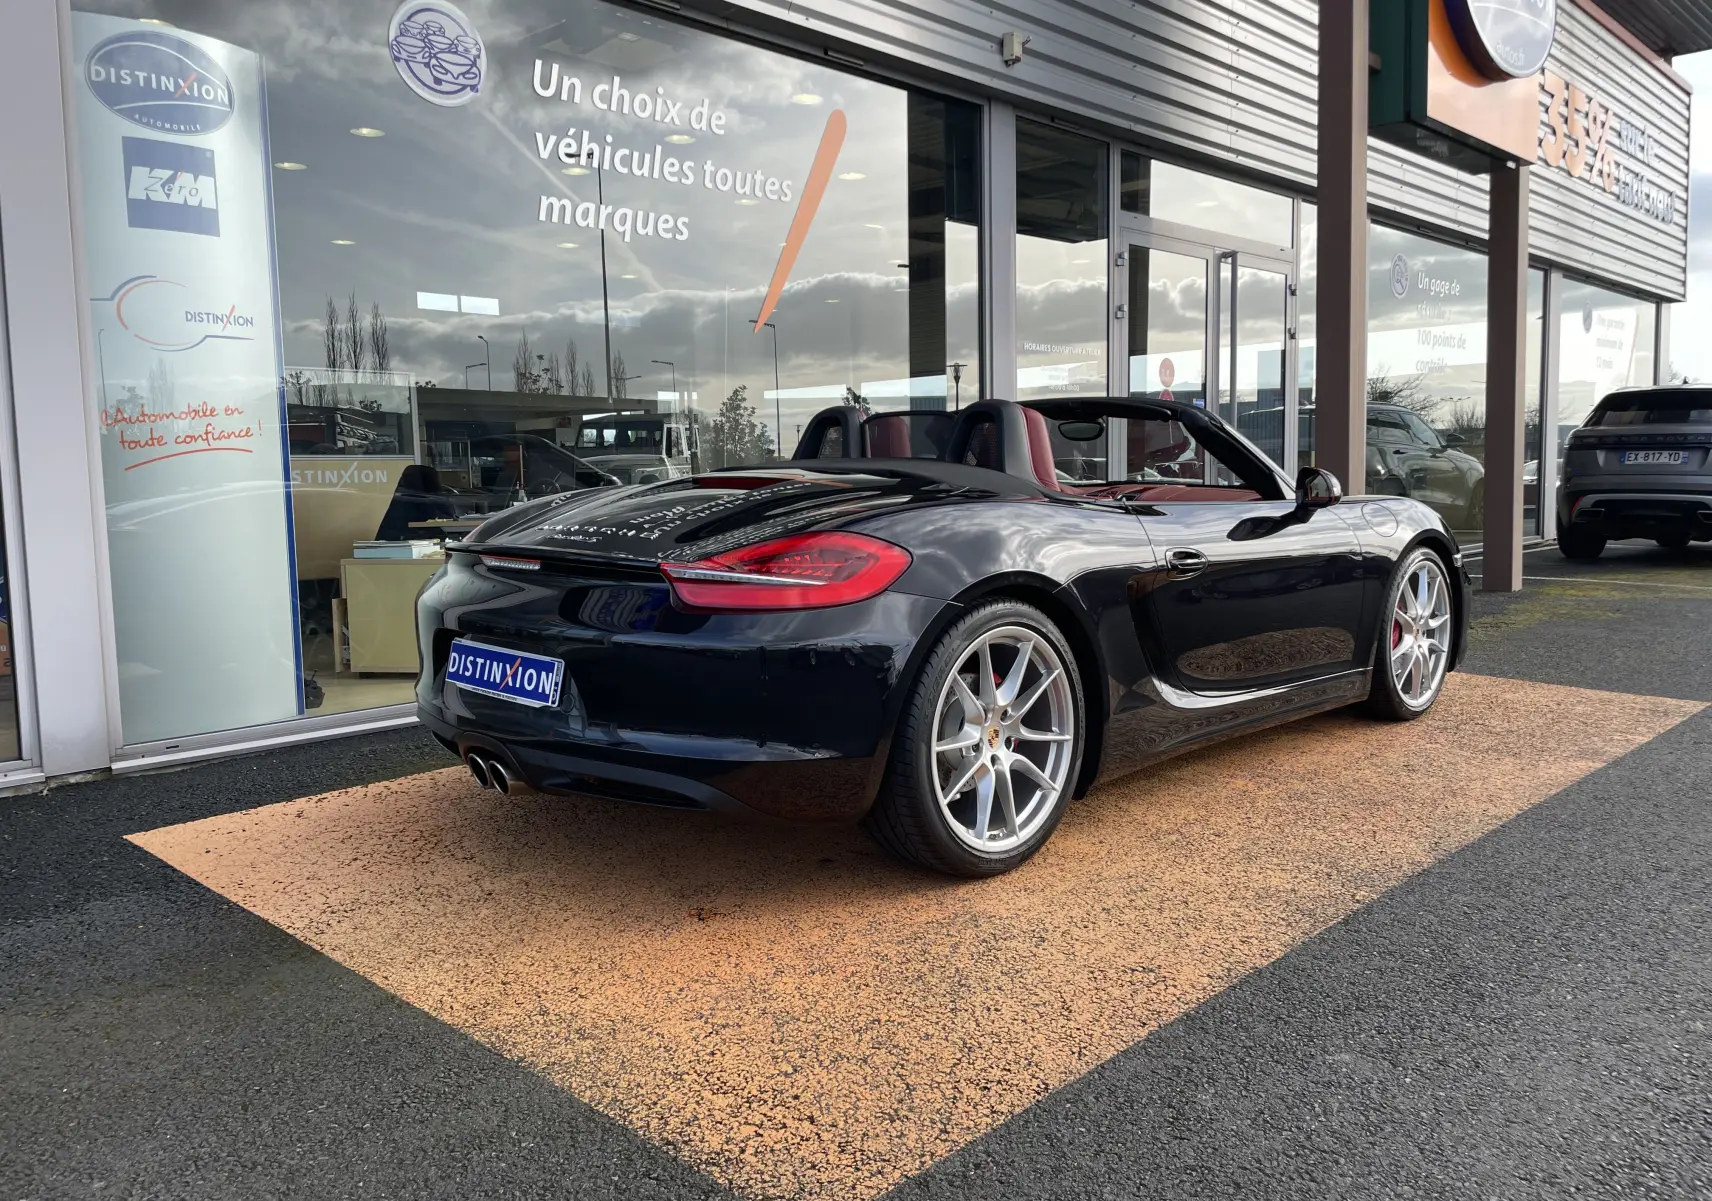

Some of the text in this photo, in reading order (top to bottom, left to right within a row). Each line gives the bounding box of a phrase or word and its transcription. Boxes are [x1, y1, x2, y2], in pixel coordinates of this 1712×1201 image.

[90, 65, 229, 105] DISTINXION
[533, 59, 726, 135] Un choix de
[134, 113, 201, 131] AUTOMOBILE
[1541, 68, 1616, 193] 35%
[535, 128, 793, 202] véhicules toutes
[538, 194, 690, 243] marques
[1417, 271, 1429, 290] Un
[1430, 278, 1450, 297] gage
[1450, 279, 1460, 297] de
[185, 304, 254, 332] DISTINXION
[1024, 342, 1051, 352] HORAIRES
[1417, 329, 1467, 351] 100 points de
[224, 404, 245, 417] en
[119, 427, 168, 450] toute
[174, 422, 254, 447] confiance
[1626, 452, 1681, 460] EX-817-YD
[291, 460, 388, 489] STINXION
[448, 652, 553, 695] DISTINXION
